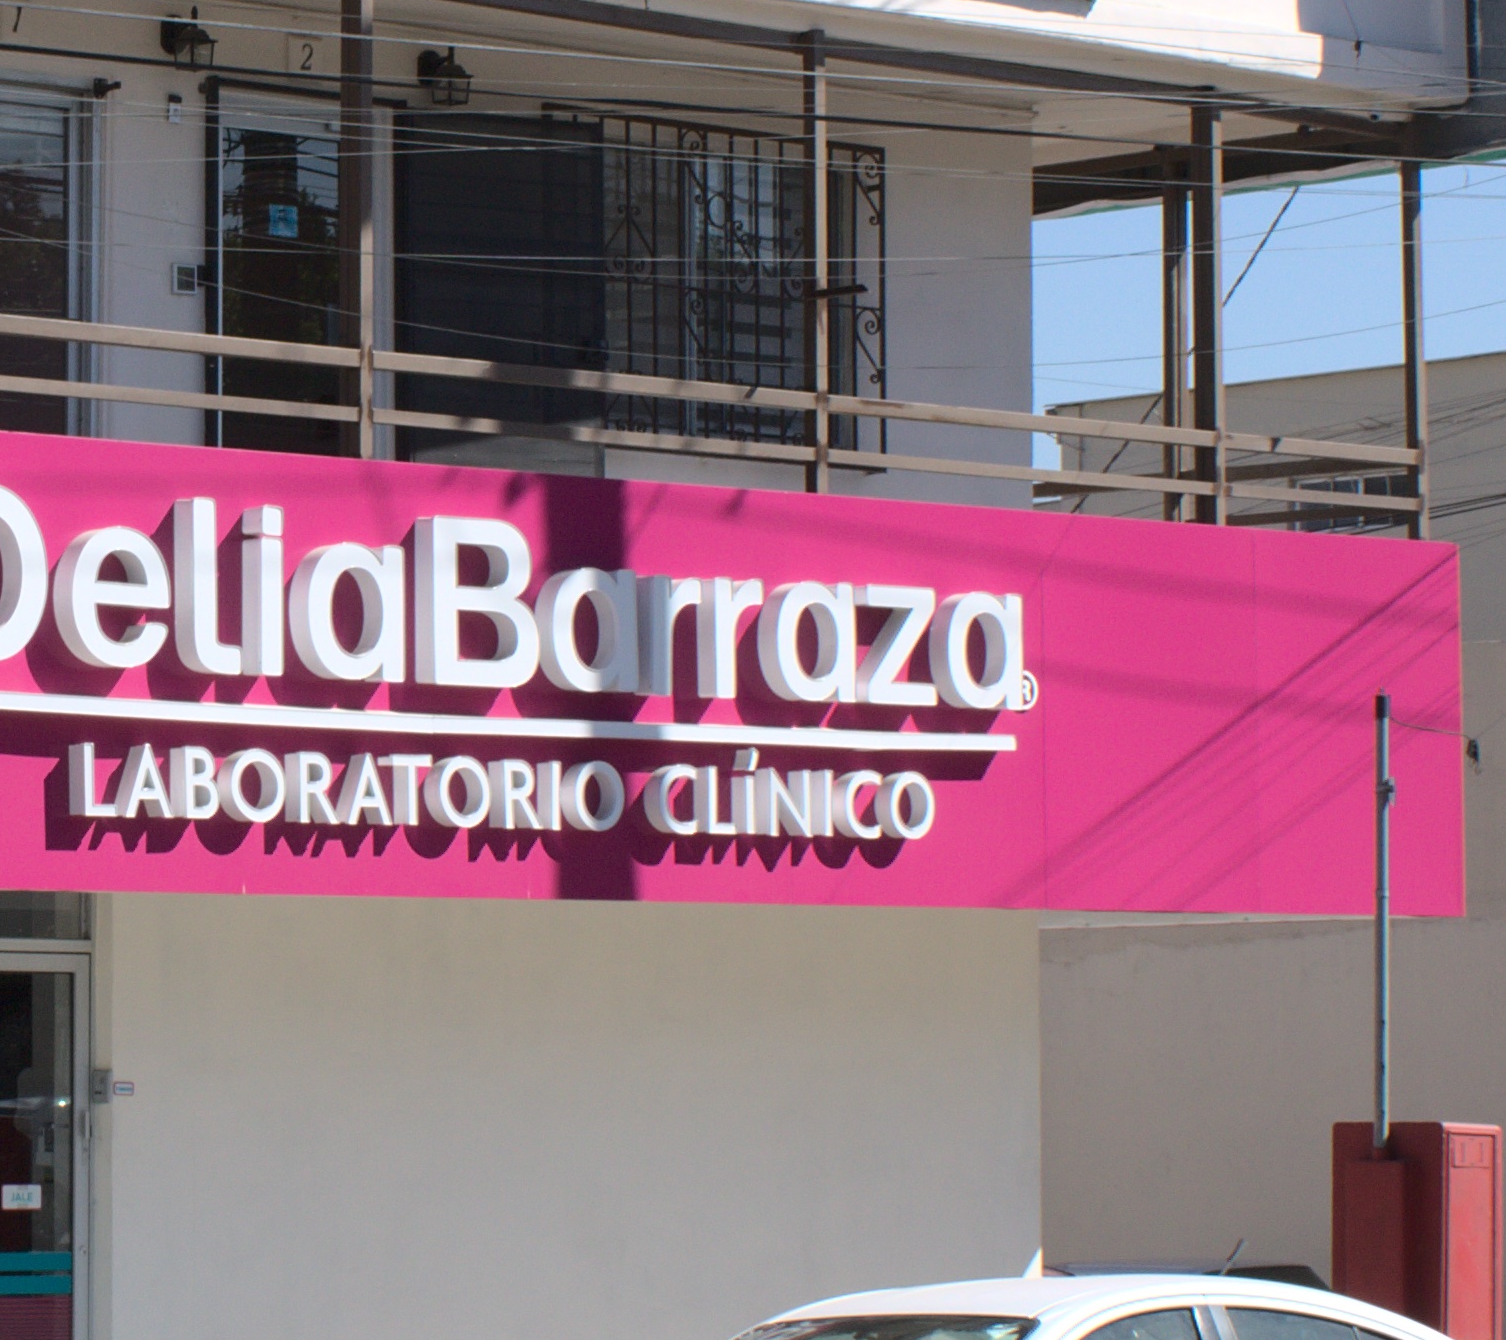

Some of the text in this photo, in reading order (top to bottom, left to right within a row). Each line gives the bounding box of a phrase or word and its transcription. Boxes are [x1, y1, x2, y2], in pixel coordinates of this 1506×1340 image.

[300, 43, 313, 70] 2
[67, 738, 936, 841] LABORATORIO CLÍNICO
